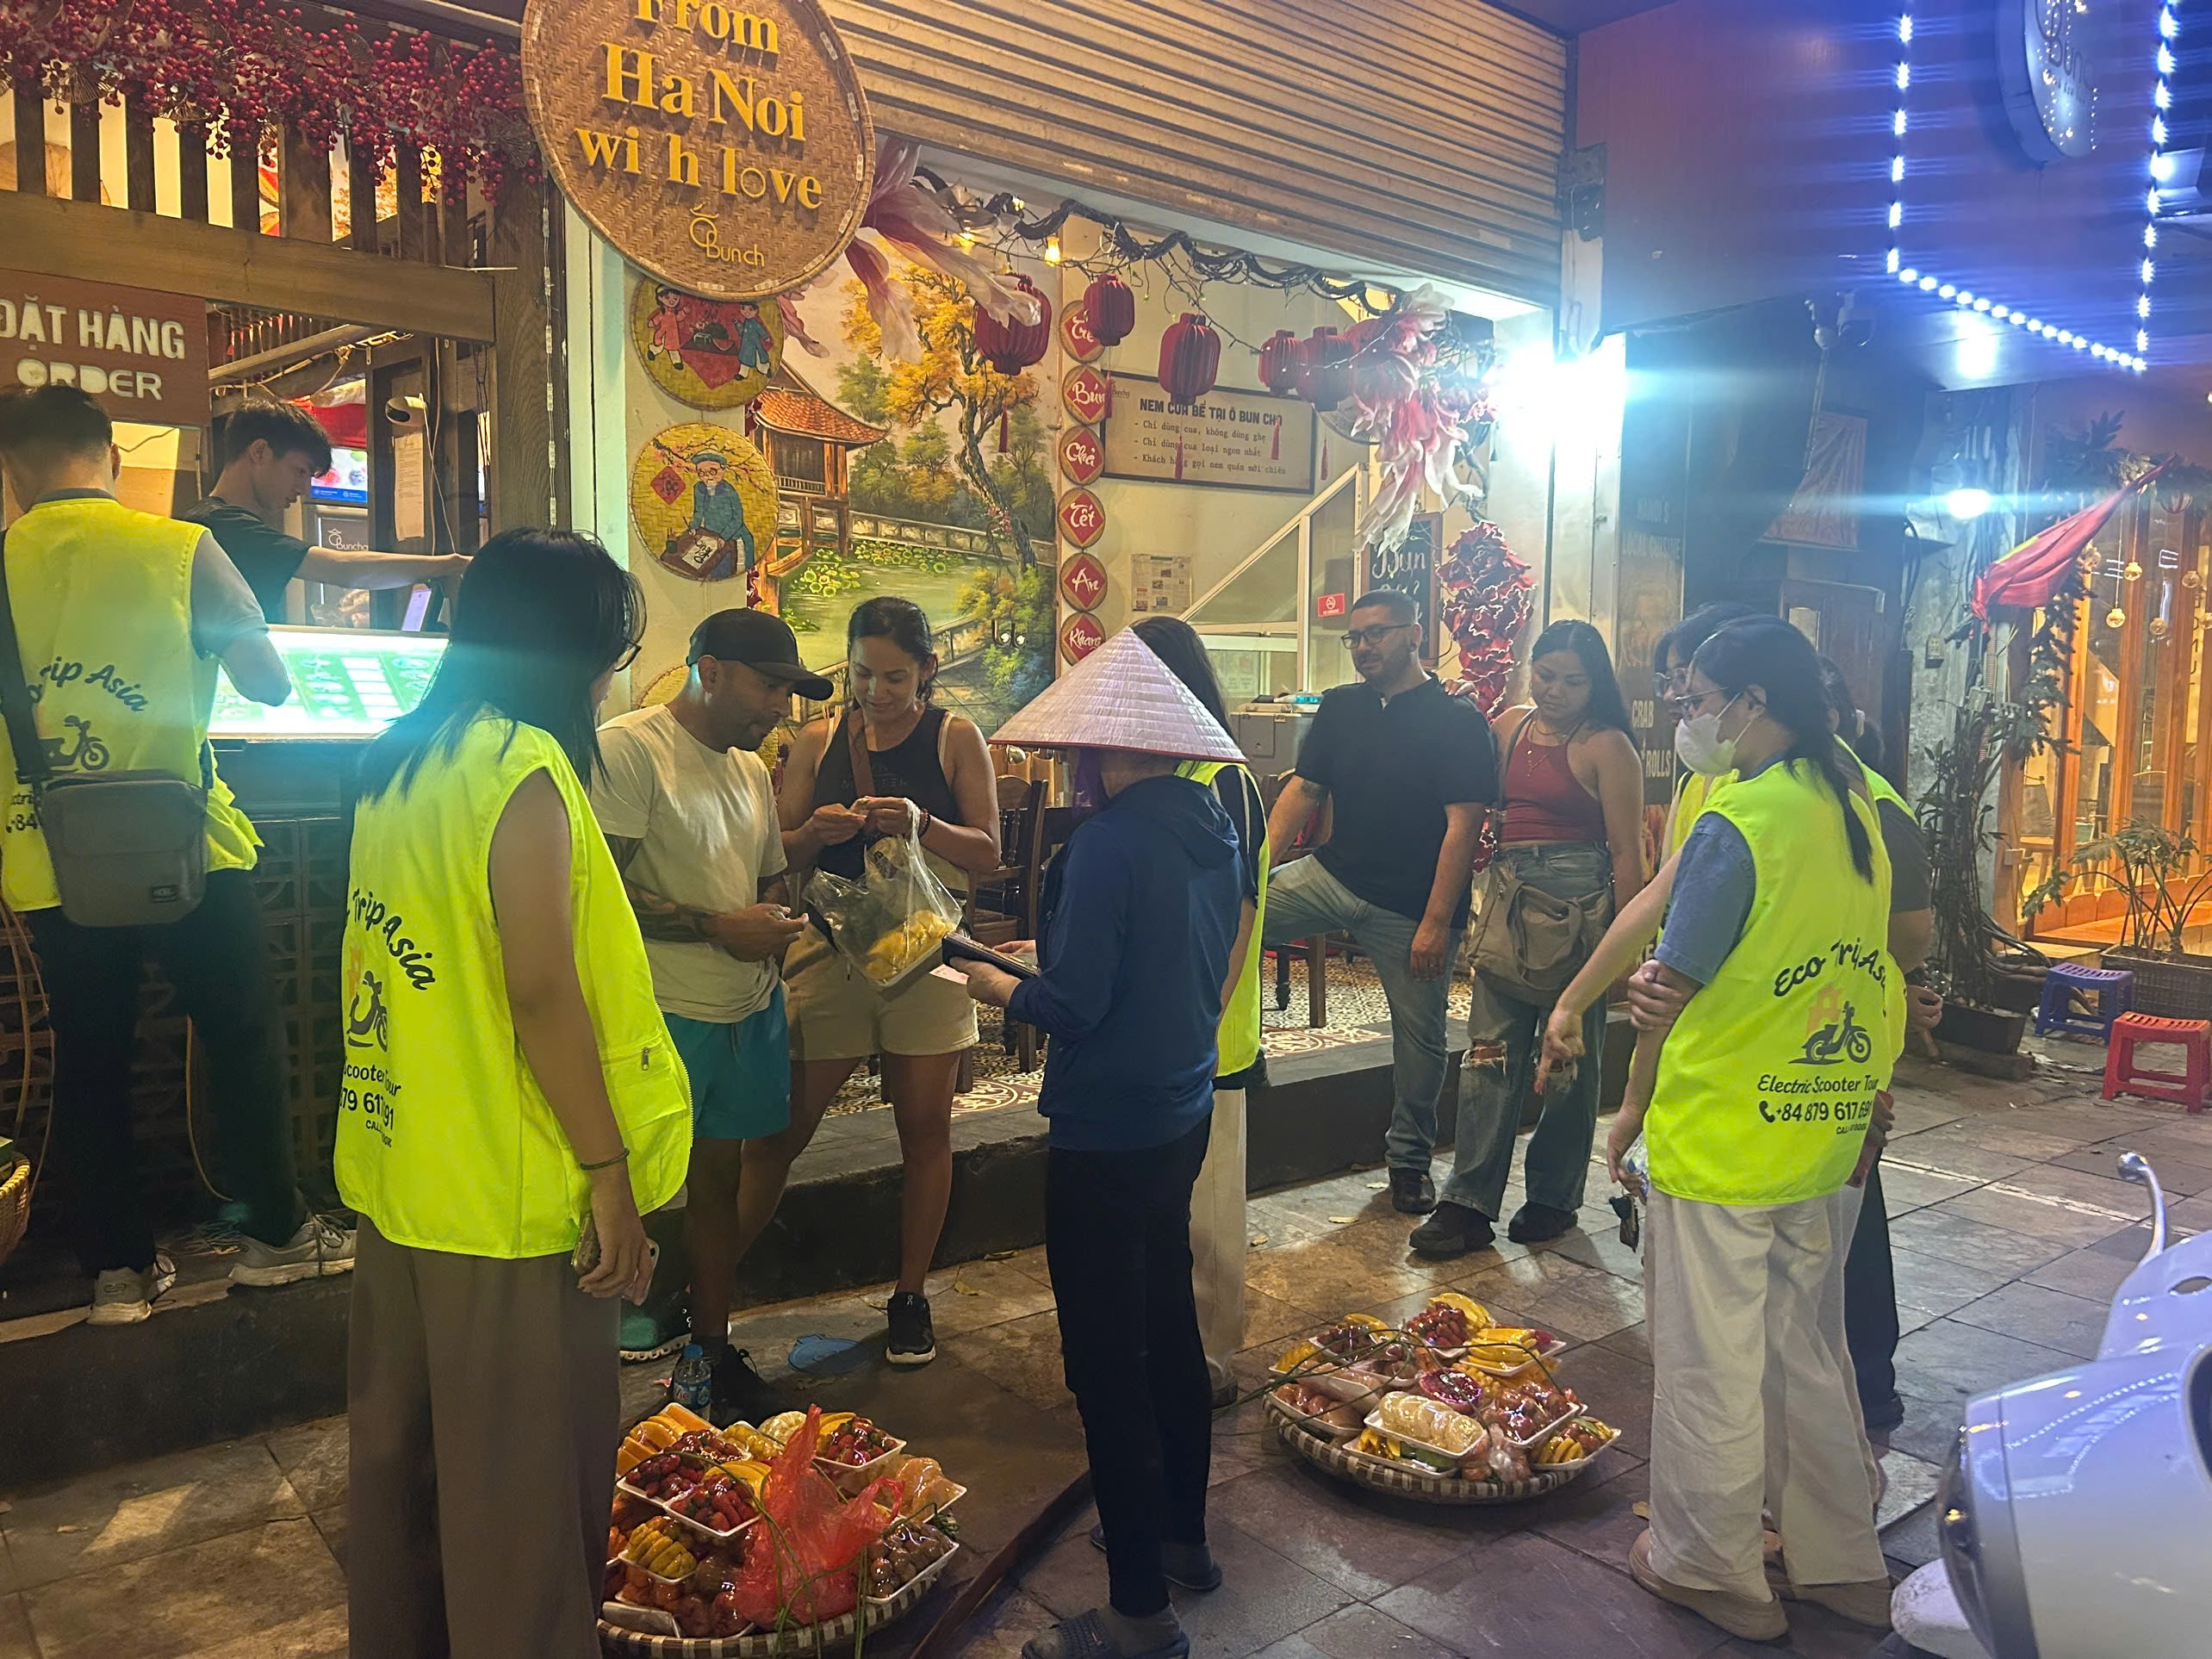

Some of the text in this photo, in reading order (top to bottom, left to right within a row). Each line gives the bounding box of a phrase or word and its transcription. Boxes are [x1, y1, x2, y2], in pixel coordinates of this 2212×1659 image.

[720, 146, 823, 209] love
[78, 304, 186, 359] HÀNG
[16, 358, 163, 401] ORDER
[1072, 381, 1105, 405] Bún
[1140, 398, 1165, 413] NEM
[1167, 401, 1189, 415] CUA
[1209, 407, 1227, 423] TẠI
[1229, 407, 1237, 421] Ô
[1239, 410, 1260, 426] BUN
[1184, 426, 1201, 435] cua,
[1206, 427, 1228, 438] không
[1222, 447, 1240, 457] ngon
[1071, 502, 1096, 528] Tết
[84, 664, 149, 711] Asia
[1631, 699, 1655, 729] CRAB
[1646, 749, 1672, 778] ROLLS
[382, 916, 436, 991] Asia
[1774, 956, 1827, 997] Eco
[1757, 1073, 1812, 1094] Electric
[1811, 1075, 1861, 1094] Scooter
[339, 1086, 358, 1111] 79
[1776, 1103, 1803, 1122] +84
[1804, 1102, 1830, 1122] 879
